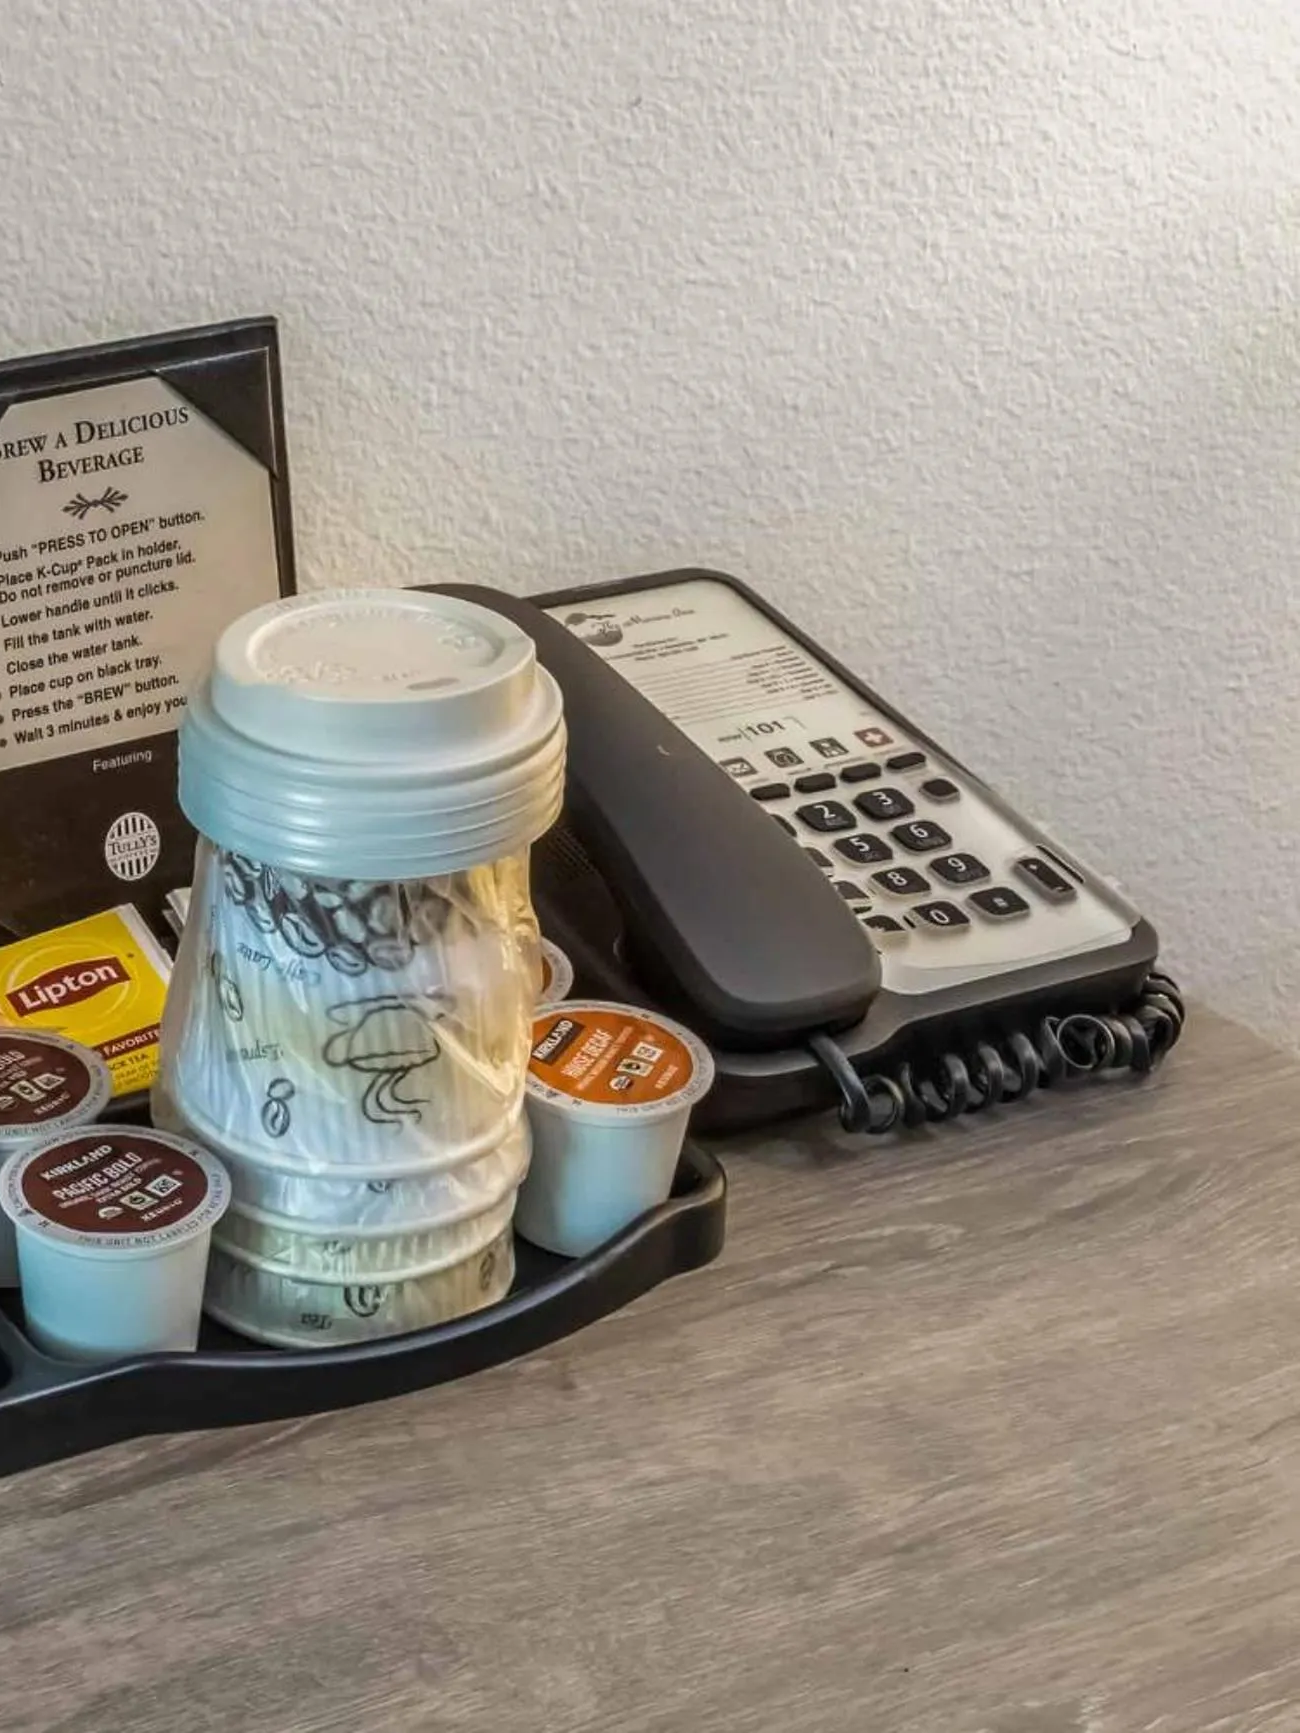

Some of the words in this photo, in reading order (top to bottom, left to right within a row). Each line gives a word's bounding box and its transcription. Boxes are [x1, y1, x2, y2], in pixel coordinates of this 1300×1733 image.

[55, 432, 68, 449] A
[74, 406, 190, 446] DELICIOUS
[38, 447, 145, 483] BEVERAGE
[88, 528, 108, 544] TO
[159, 511, 205, 529] button.
[86, 550, 118, 569] Pack
[121, 548, 134, 560] in
[137, 540, 181, 558] holder.
[21, 584, 43, 600] not
[46, 574, 95, 594] remove
[98, 571, 112, 583] or
[115, 557, 173, 582] puncture
[176, 550, 196, 566] lid.
[1, 610, 42, 628] Lower
[45, 598, 90, 618] handle
[93, 590, 122, 608] until
[126, 587, 134, 600] it
[137, 580, 179, 598] clicks.
[4, 635, 25, 652] Fill
[27, 632, 49, 646] the
[52, 624, 82, 641] tank
[84, 618, 112, 634] with
[114, 609, 154, 627] water.
[6, 658, 45, 675] Close
[48, 652, 69, 666] the
[71, 644, 109, 660] water
[111, 635, 143, 651] tank.
[9, 682, 46, 699] Place
[49, 674, 74, 689] cup
[76, 670, 94, 684] on
[97, 659, 133, 678] black
[135, 654, 162, 670] tray.
[12, 705, 50, 721] Press
[53, 699, 74, 713] the
[134, 674, 179, 694] button.
[13, 726, 44, 745] Wait
[46, 724, 55, 737] 3
[58, 715, 110, 735] minutes
[113, 708, 123, 722] &
[126, 702, 162, 719] enjoy
[164, 695, 188, 714] you
[745, 720, 787, 737] 101
[92, 750, 153, 773] Featuring
[813, 804, 837, 819] 2
[872, 791, 892, 805] 3
[850, 836, 870, 852] 5
[909, 824, 929, 838] 6
[887, 871, 908, 886] 8
[947, 857, 966, 873] 9
[929, 908, 950, 924] 0
[18, 962, 118, 1010] Lipton
[532, 1018, 575, 1060] KIRKLAND
[40, 1144, 113, 1181] KIRKLAND
[52, 1172, 109, 1201] PACIFIC
[102, 1151, 143, 1182] BOLD
